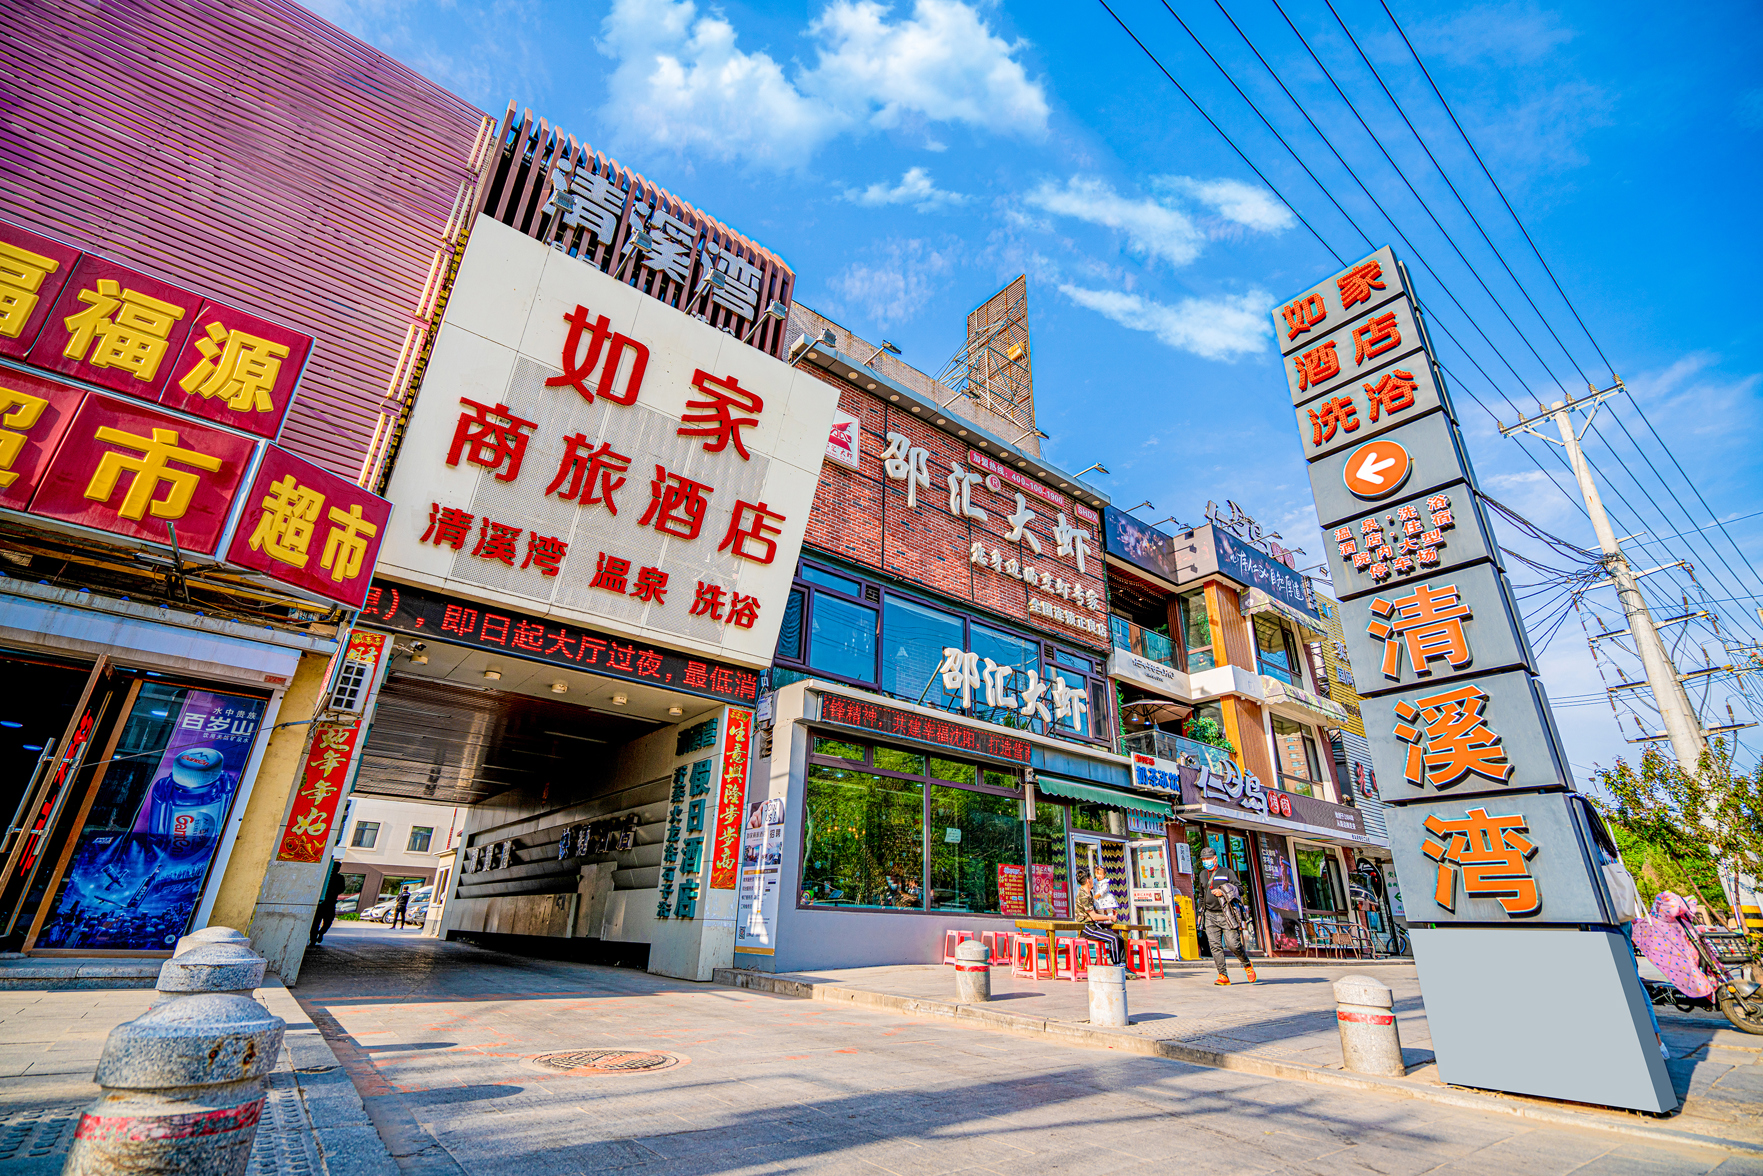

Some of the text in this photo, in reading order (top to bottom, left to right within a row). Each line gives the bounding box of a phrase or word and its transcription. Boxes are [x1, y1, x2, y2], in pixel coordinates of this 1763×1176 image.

[541, 158, 762, 322] 清溪湾
[1281, 259, 1389, 341] 如家
[545, 304, 765, 462] 如家
[1292, 311, 1402, 391] 酒店
[1306, 368, 1420, 446] 洗浴
[445, 396, 787, 566] 商旅酒店
[880, 431, 1092, 574] 邵汇大虾
[1077, 506, 1098, 521] SHDX
[248, 474, 378, 583] 超市
[418, 502, 763, 630] 清溪湾 温泉 洗浴
[1352, 527, 1446, 573] 院内大型
[1368, 547, 1441, 580] 停车场
[181, 712, 254, 736] 百岁山
[213, 707, 258, 720] 水中贵族
[940, 647, 1087, 732] 邵汇大虾
[1366, 583, 1544, 917] 清溪湾
[674, 759, 712, 919] 假日酒店
